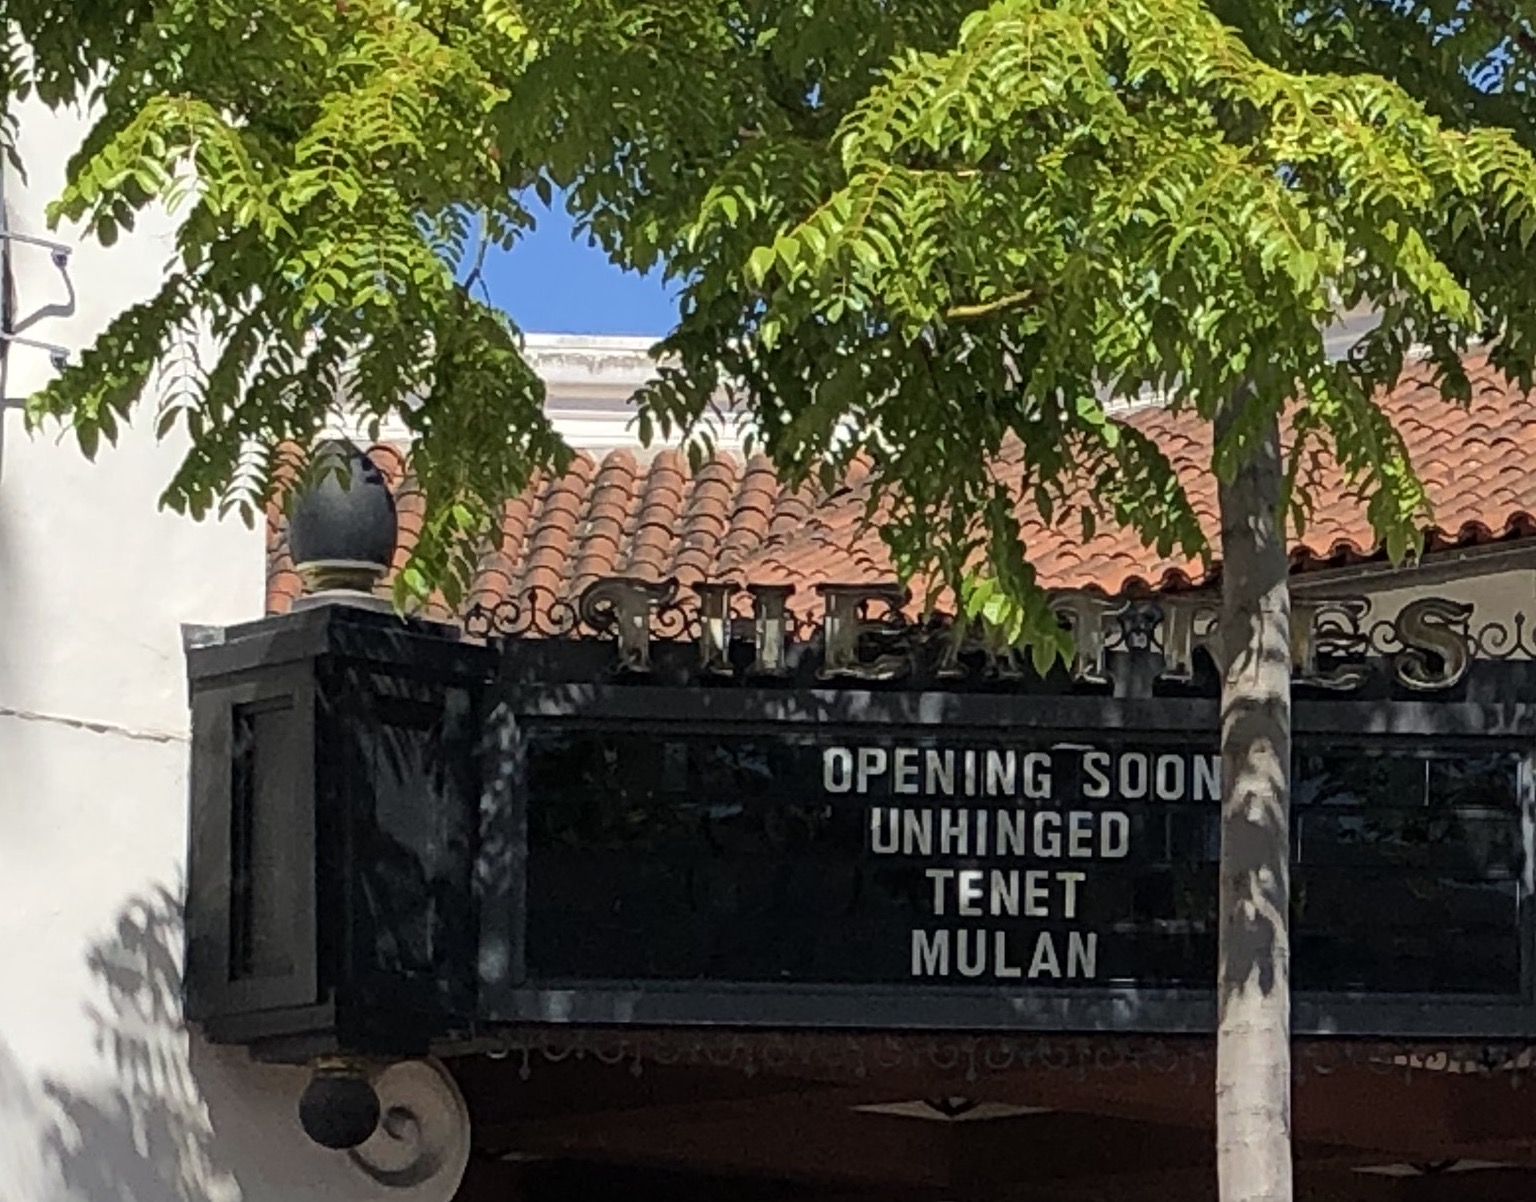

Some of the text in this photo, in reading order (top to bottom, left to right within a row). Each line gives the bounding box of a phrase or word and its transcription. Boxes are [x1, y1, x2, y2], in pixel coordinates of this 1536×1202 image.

[823, 747, 1222, 800] OPENING SOON
[871, 807, 1130, 858] UNHINGED
[925, 868, 1086, 919] TENET
[911, 929, 1098, 978] MULAN
